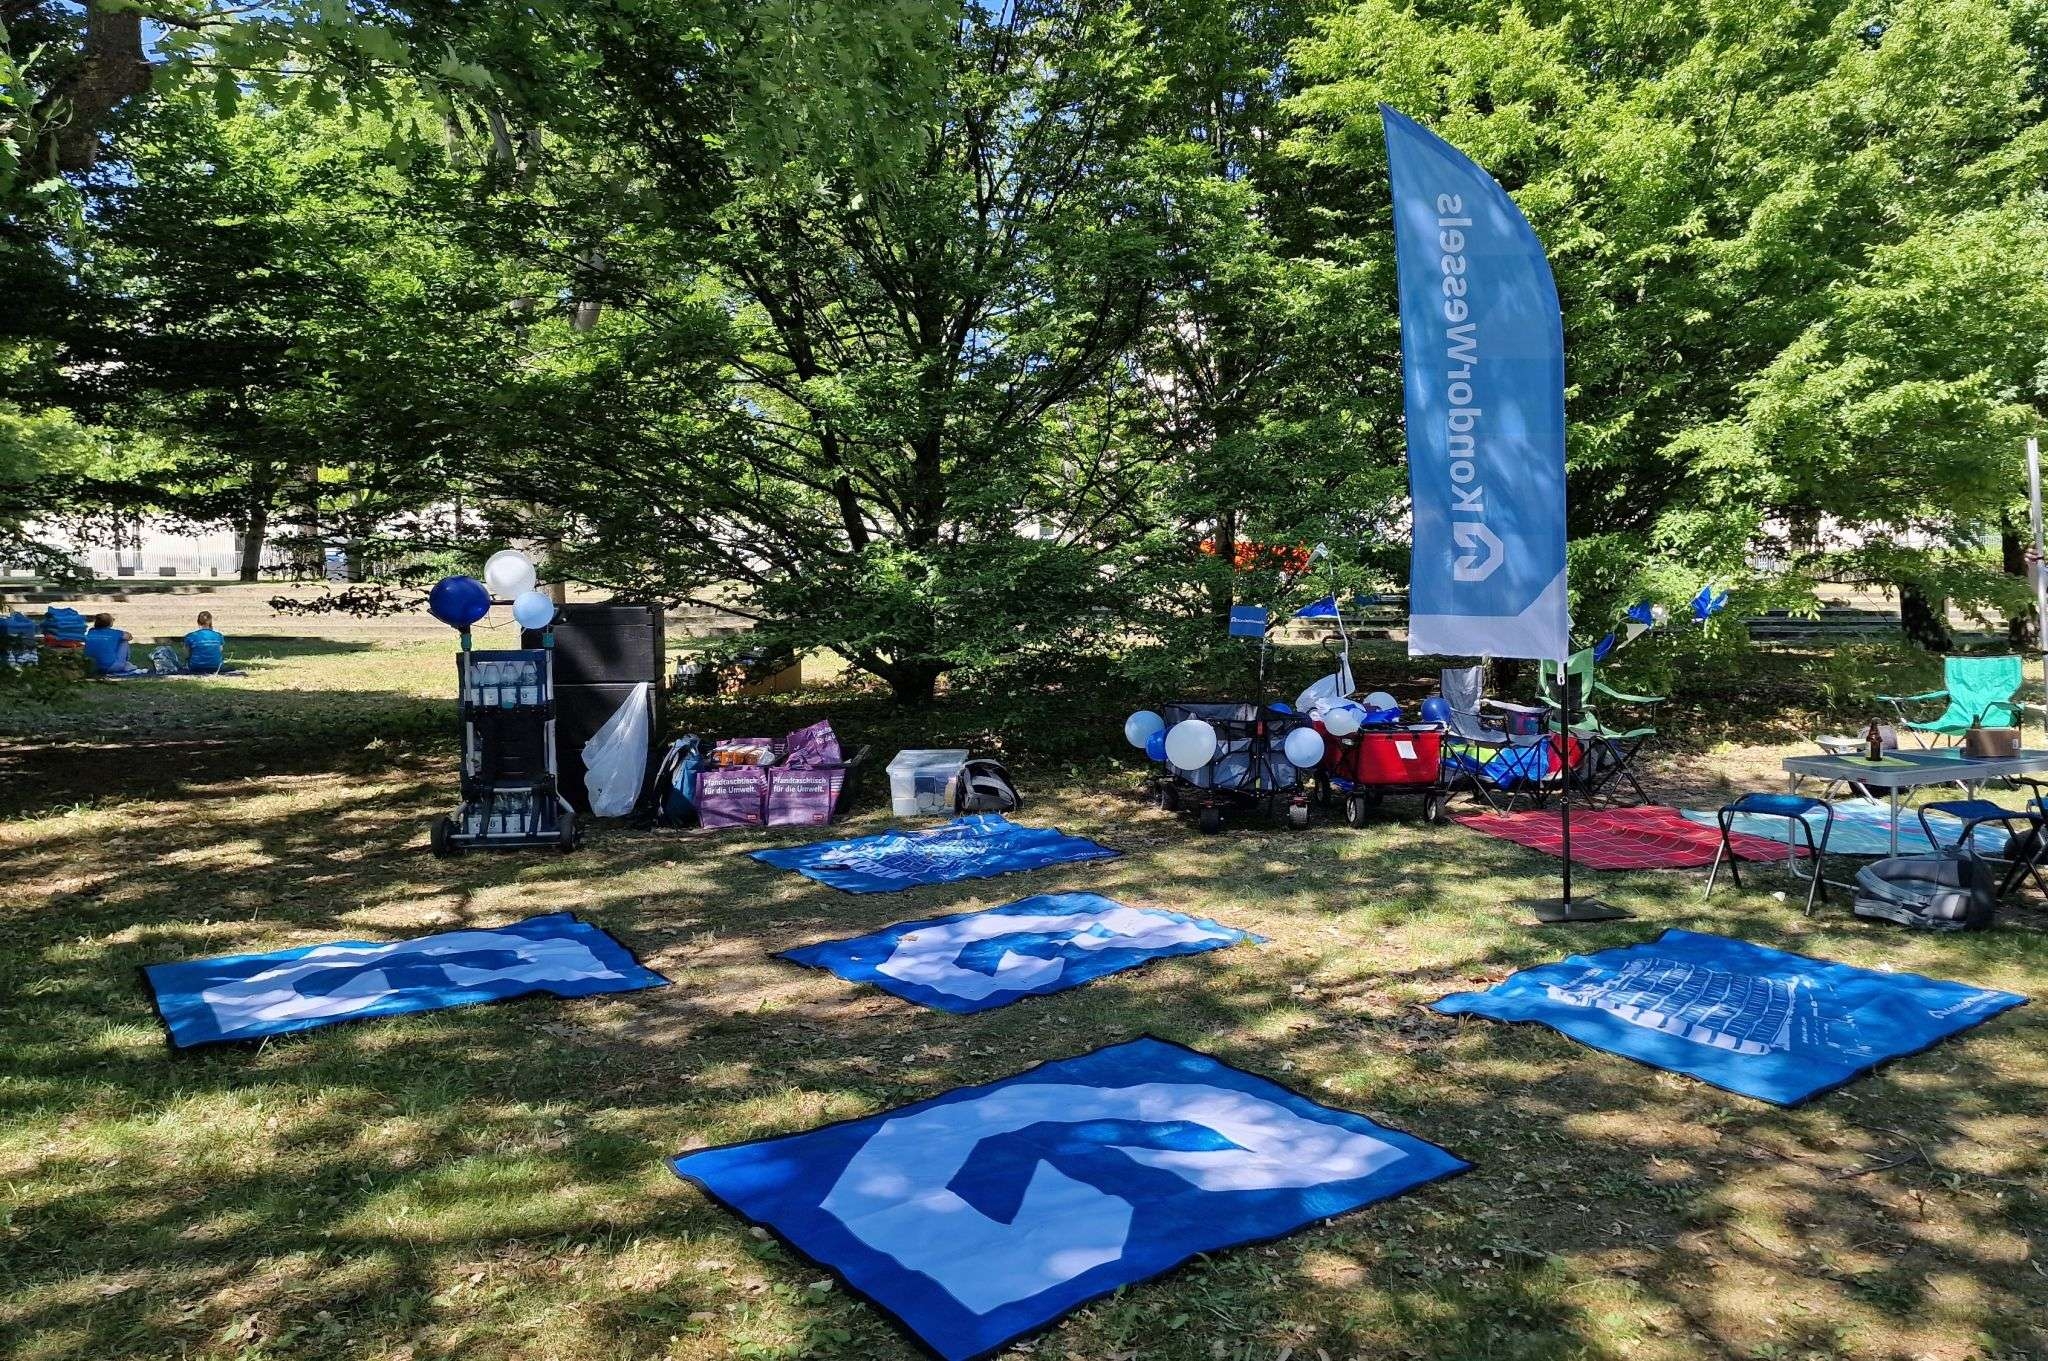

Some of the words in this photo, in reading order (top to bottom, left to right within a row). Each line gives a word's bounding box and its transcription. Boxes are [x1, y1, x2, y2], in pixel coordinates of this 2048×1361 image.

[704, 787, 715, 795] für
[716, 786, 727, 794] die
[728, 784, 757, 794] Umwelt.
[773, 785, 784, 793] für
[785, 785, 796, 793] die
[797, 784, 825, 793] Umwelt.
